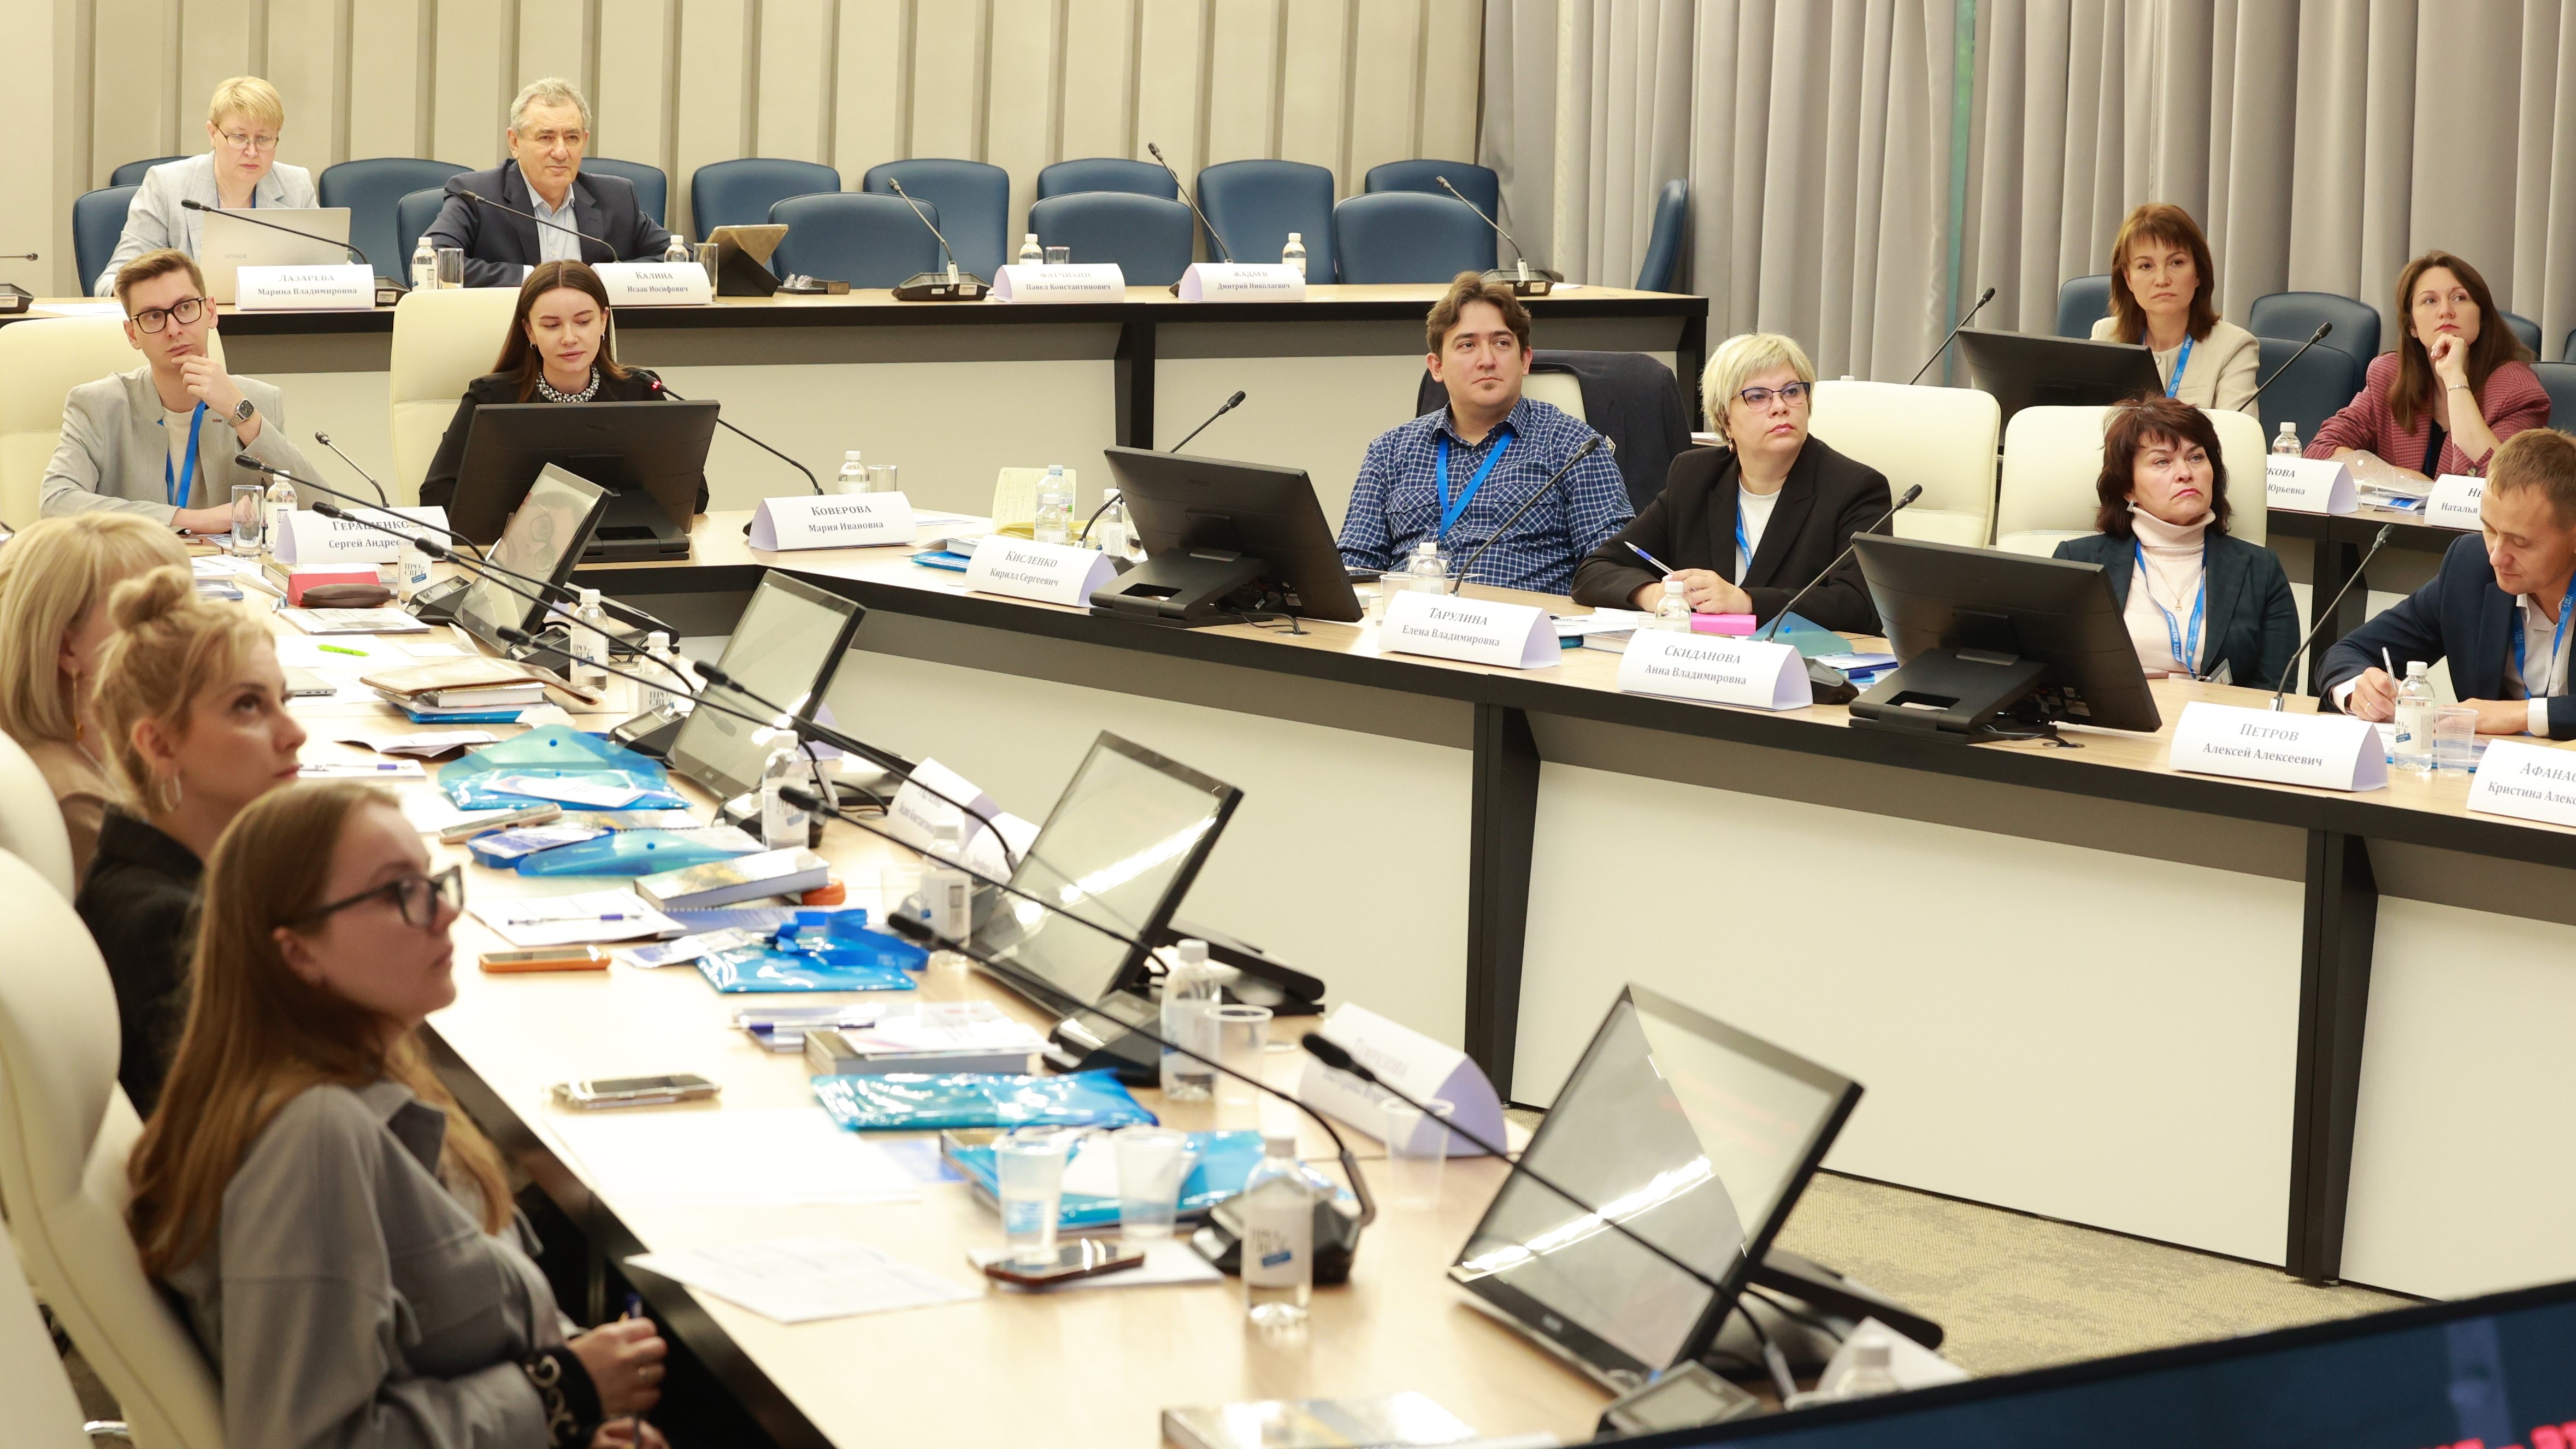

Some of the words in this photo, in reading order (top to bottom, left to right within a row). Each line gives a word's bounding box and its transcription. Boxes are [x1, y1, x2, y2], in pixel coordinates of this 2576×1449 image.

[257, 288, 291, 297] Марина
[293, 287, 357, 296] Владимировна
[2266, 467, 2296, 478] КОВА
[2268, 484, 2306, 495] Юрьевна
[811, 505, 872, 516] КОВЕРОВА
[2441, 502, 2478, 514] Наталья
[809, 525, 838, 534] Мария
[840, 522, 883, 531] Ивановна
[329, 538, 363, 550] Сергей
[366, 538, 414, 548] Андрее
[1005, 551, 1058, 568] КИСЛЕНКО
[990, 568, 1019, 580] Кирилл
[1020, 573, 1059, 586] Сергеевич
[1429, 608, 1488, 625] ТАРУЛИНА
[1402, 625, 1430, 637] Елена
[1431, 628, 1500, 646] Владимировна
[1665, 645, 1741, 663] СКИДАНОВА
[1644, 664, 1670, 676] Анна
[1672, 667, 1747, 685] Владимировна
[2239, 723, 2299, 741] ПЕТРОВ
[2203, 743, 2251, 758] Алексей
[2253, 749, 2322, 766] Алексеевич
[2487, 781, 2542, 799] Кристина
